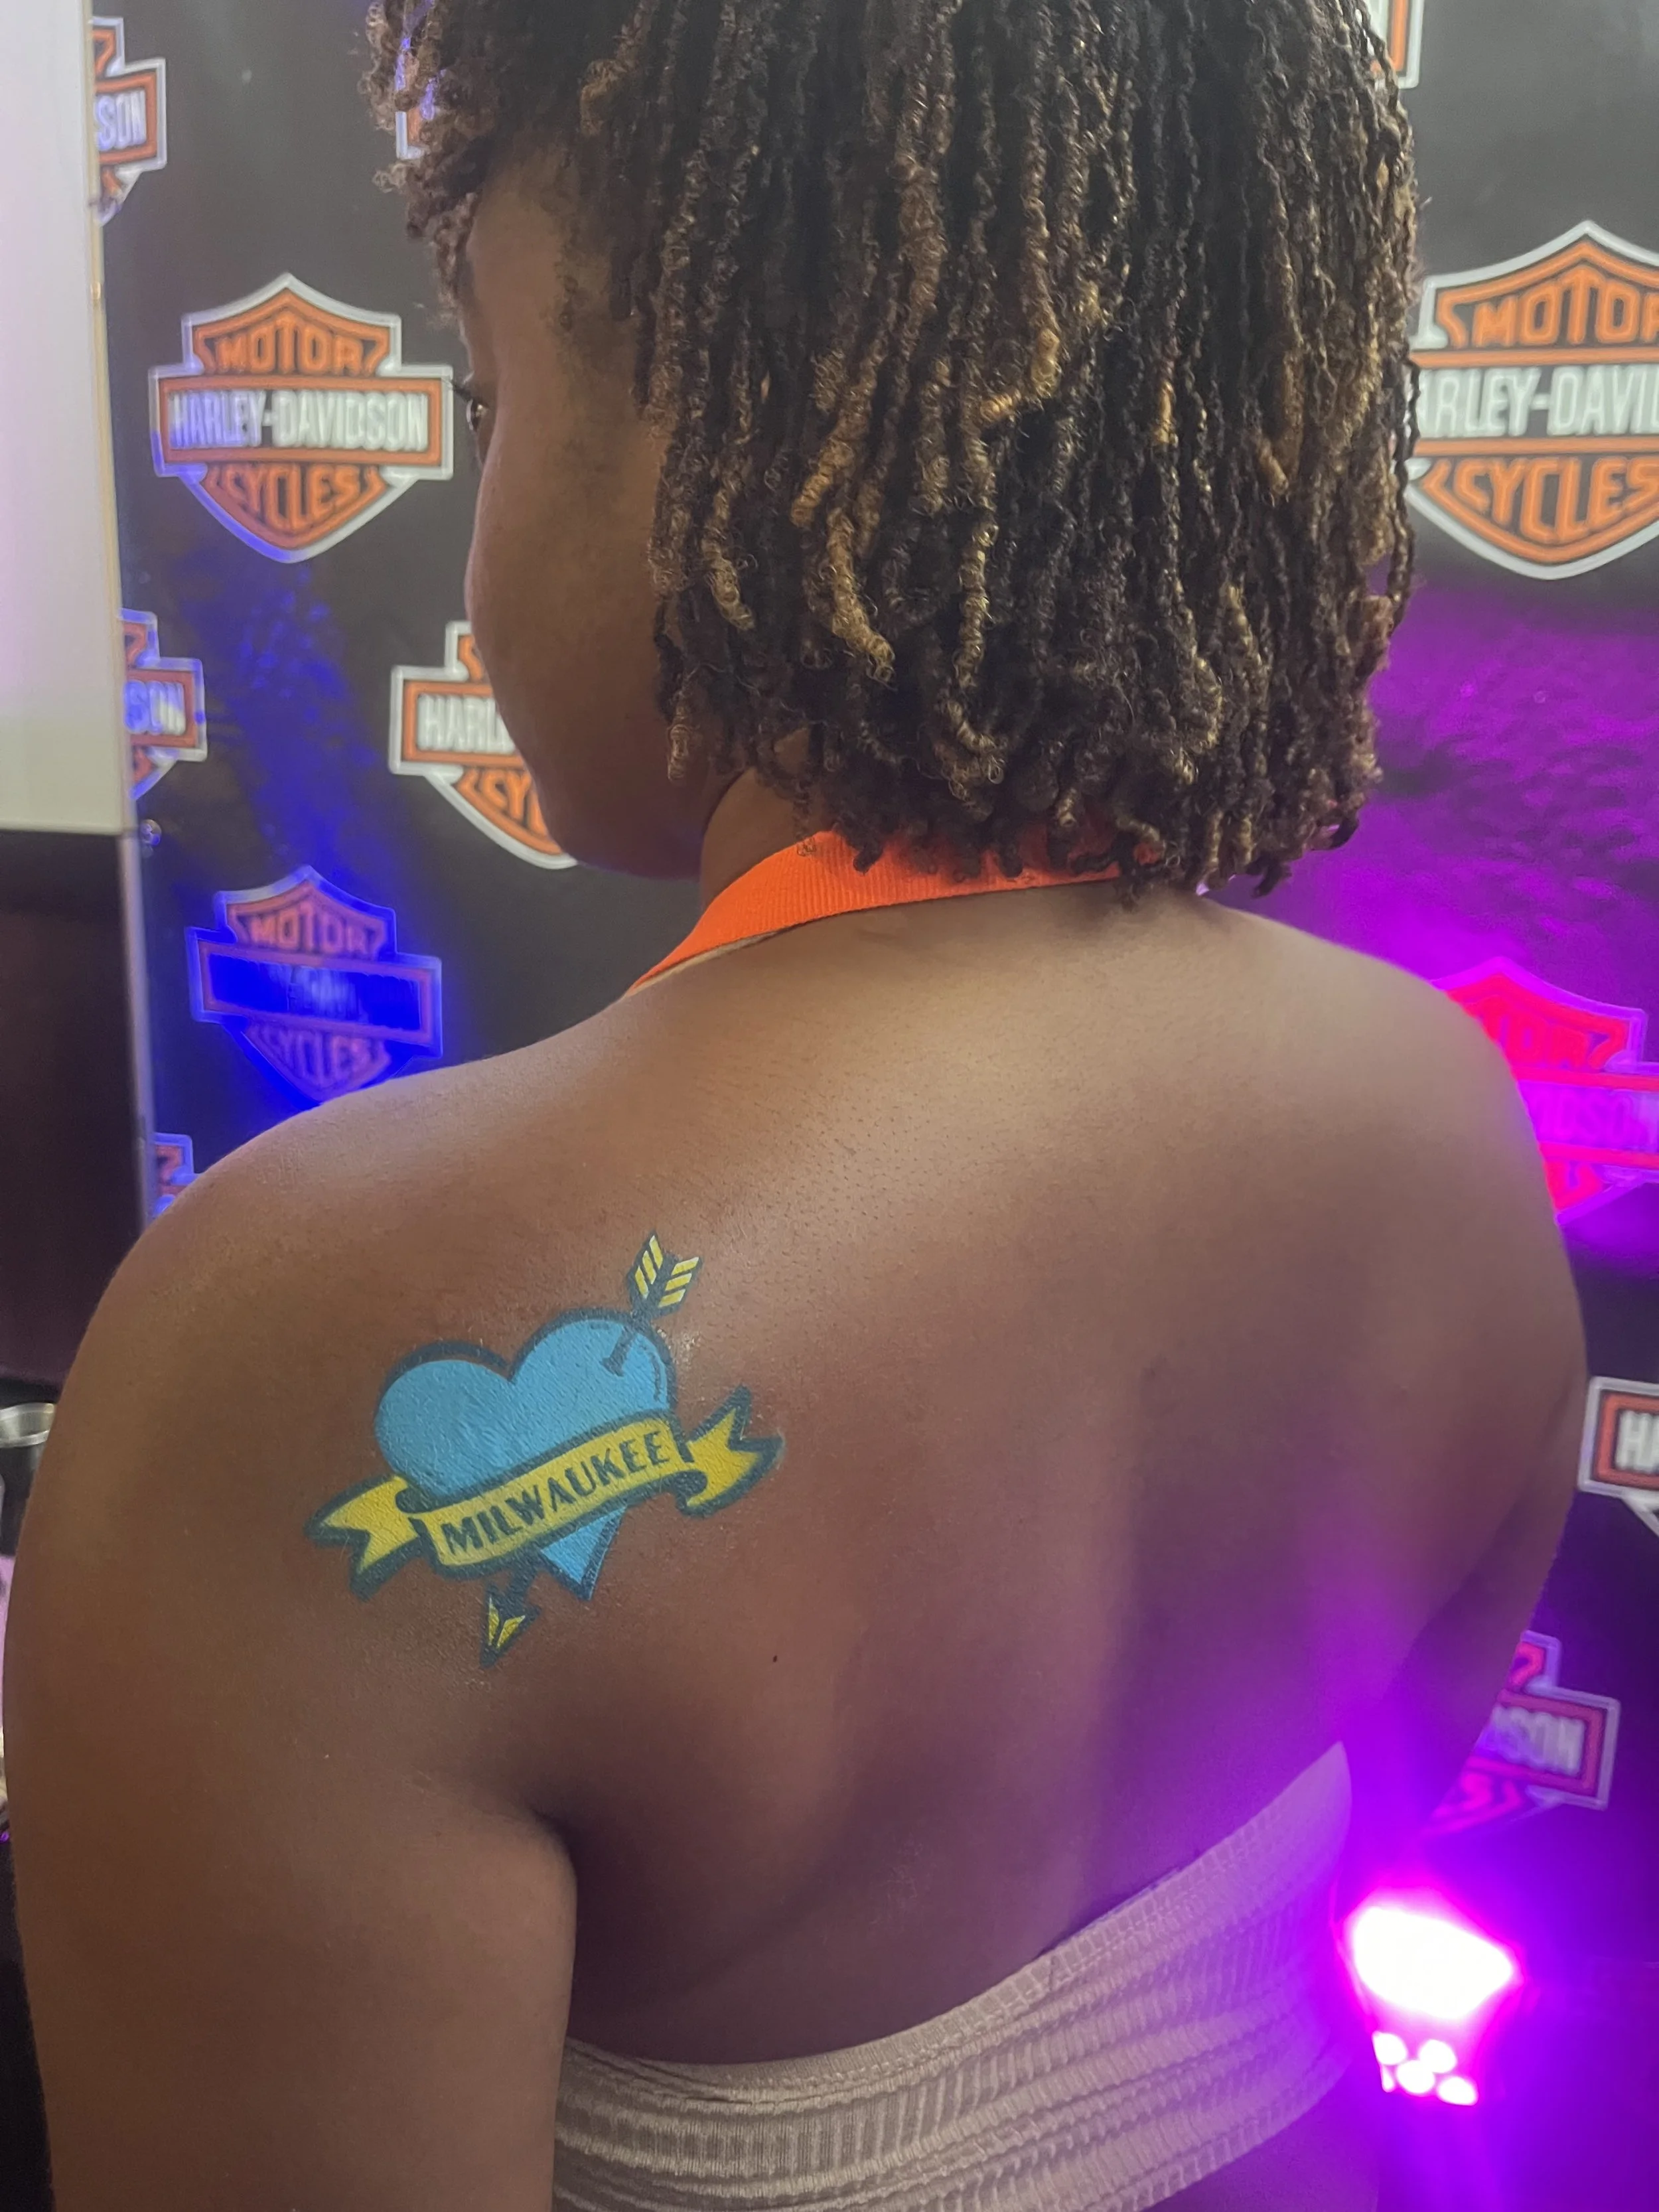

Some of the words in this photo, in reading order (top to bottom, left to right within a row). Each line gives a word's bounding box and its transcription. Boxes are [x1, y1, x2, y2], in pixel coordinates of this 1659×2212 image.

[215, 312, 363, 375] MOTOR
[167, 388, 429, 451] HARLEY-DAVIDSON
[225, 464, 361, 532] CYCLES
[247, 900, 369, 958] MOTOR
[259, 1026, 373, 1090] CYCLES
[439, 1430, 670, 1556] MILWAUKEE
